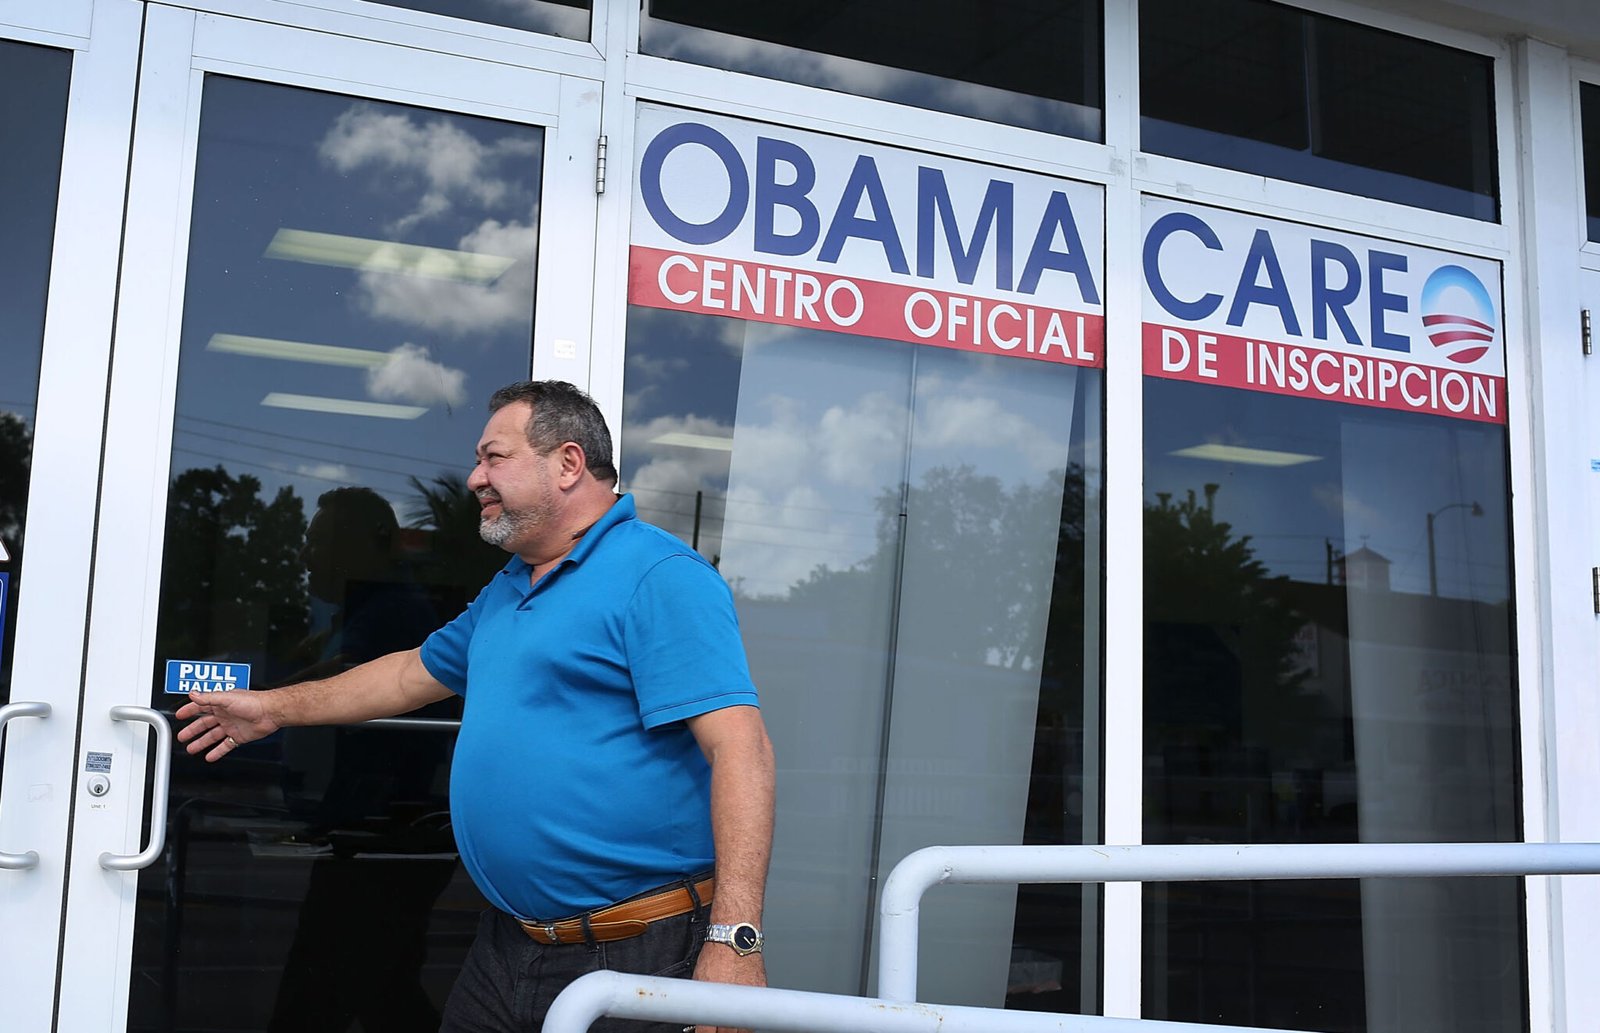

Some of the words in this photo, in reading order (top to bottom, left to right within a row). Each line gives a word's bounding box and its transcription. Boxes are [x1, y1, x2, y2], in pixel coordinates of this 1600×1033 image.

[640, 122, 1101, 305] OBAMA
[1142, 212, 1411, 353] CARE
[657, 254, 865, 328] CENTRO
[903, 291, 1096, 362] OFICIAL
[1161, 329, 1218, 378] DE
[1245, 341, 1497, 418] INSCRIPCION
[179, 663, 238, 682] PULL
